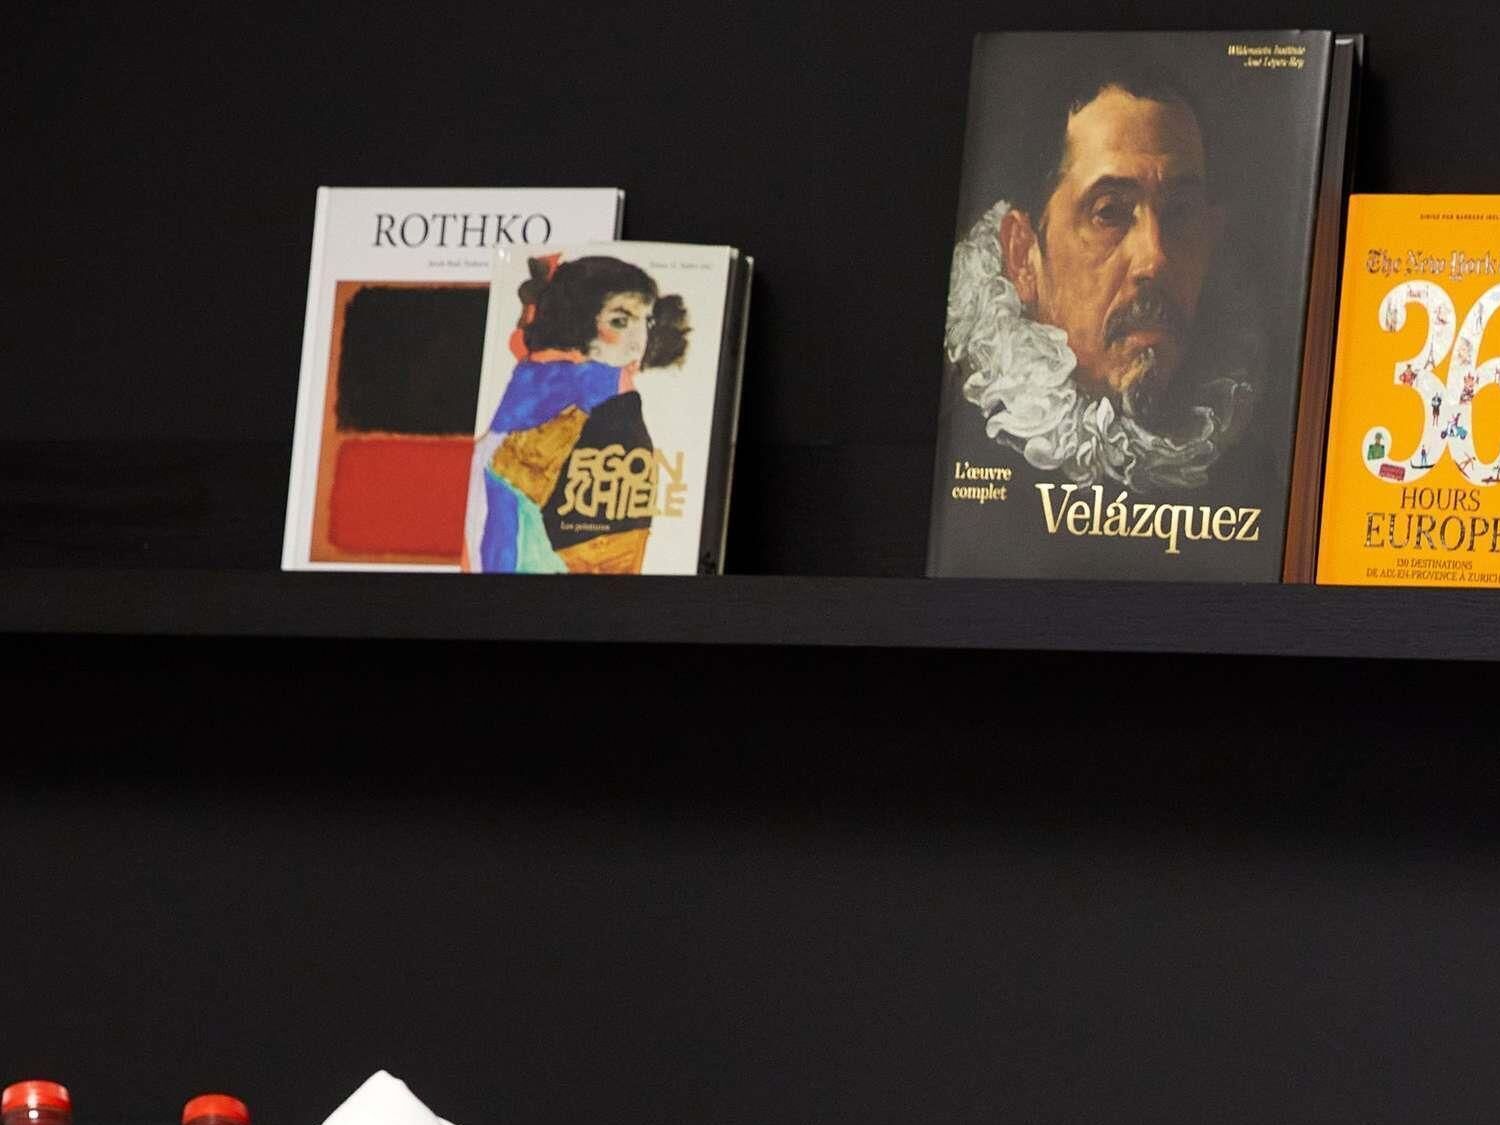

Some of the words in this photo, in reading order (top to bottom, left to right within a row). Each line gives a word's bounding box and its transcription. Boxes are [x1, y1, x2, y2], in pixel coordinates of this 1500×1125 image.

[373, 213, 551, 248] ROTHKO
[1366, 249, 1400, 277] The
[1406, 250, 1446, 276] New
[1450, 250, 1496, 280] York
[567, 444, 685, 482] EGON
[557, 473, 688, 520] SCHIELE
[952, 483, 1007, 503] complet
[1400, 487, 1481, 512] HOURS
[1035, 483, 1261, 554] Velázquez
[1366, 568, 1378, 578] DE
[1467, 573, 1500, 584] ZURICH
[1410, 559, 1473, 570] DESTINATIONS
